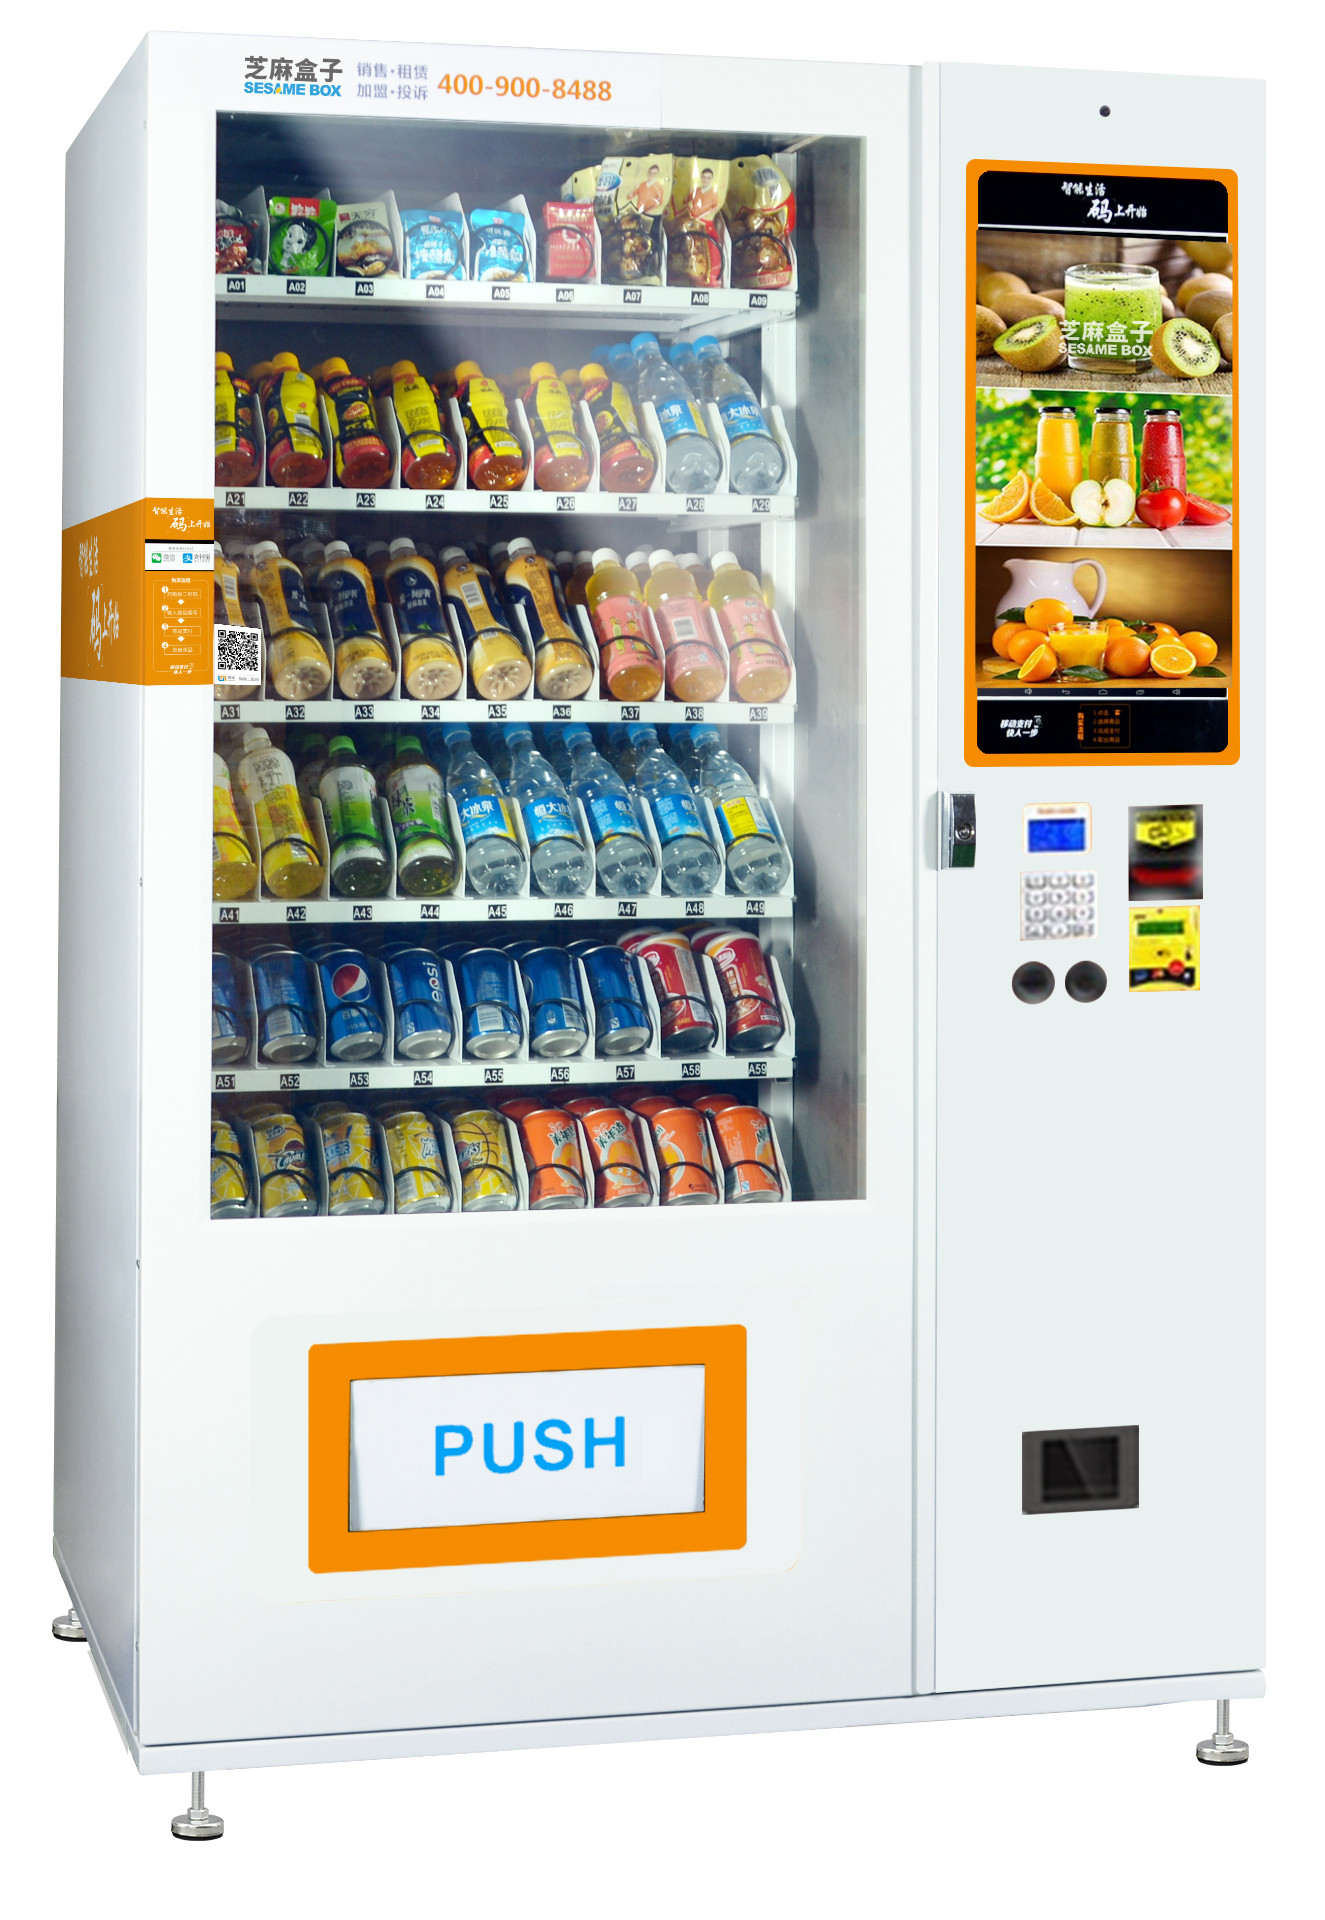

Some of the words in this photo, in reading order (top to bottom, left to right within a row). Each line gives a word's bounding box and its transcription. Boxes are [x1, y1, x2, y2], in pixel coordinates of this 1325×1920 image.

[244, 56, 343, 83] 芝麻盒子
[244, 81, 305, 96] SESAME
[309, 84, 342, 97] BOX
[437, 73, 612, 102] 400-900-8488
[1061, 181, 1106, 197] 智能生活
[1087, 198, 1148, 224] 码上开始
[228, 280, 245, 290] A01
[289, 281, 306, 292] A02
[356, 284, 374, 294] A03
[428, 287, 444, 297] A04
[494, 288, 510, 298] A05
[557, 290, 574, 300] A06
[625, 292, 641, 302] A07
[692, 293, 709, 304] A08
[750, 296, 767, 306] A09
[1059, 320, 1153, 343] 芝麻盒子
[1058, 342, 1117, 356] SESAME
[1121, 344, 1153, 357] BOX
[227, 493, 245, 505] A21
[289, 493, 308, 506] A22
[356, 494, 375, 506] A23
[426, 496, 444, 508] A24
[490, 495, 508, 507] A25
[556, 497, 575, 510] A26
[618, 498, 637, 511] A27
[686, 499, 705, 511] A28
[752, 499, 770, 511] A29
[221, 707, 240, 718] A31
[286, 707, 305, 718] A32
[355, 706, 374, 718] A33
[421, 706, 440, 718] A34
[488, 706, 507, 717] A35
[553, 706, 571, 718] A36
[621, 708, 640, 719] A37
[685, 708, 704, 720] A38
[750, 708, 768, 720] A39
[353, 907, 372, 919] A43
[421, 906, 439, 918] A44
[488, 906, 507, 917] A45
[554, 904, 573, 916] A46
[618, 903, 637, 915] A47
[686, 902, 704, 914] A48
[746, 902, 765, 913] A49
[220, 909, 239, 920] A41
[287, 908, 306, 920] A42
[551, 1069, 570, 1080] A56
[616, 1067, 635, 1078] A57
[682, 1064, 700, 1076] A58
[748, 1063, 767, 1074] A59
[216, 1076, 235, 1088] A51
[280, 1075, 300, 1087] A52
[350, 1074, 369, 1085] A53
[414, 1072, 433, 1084] A54
[485, 1070, 503, 1082] A55
[434, 1416, 626, 1477] PUSH
